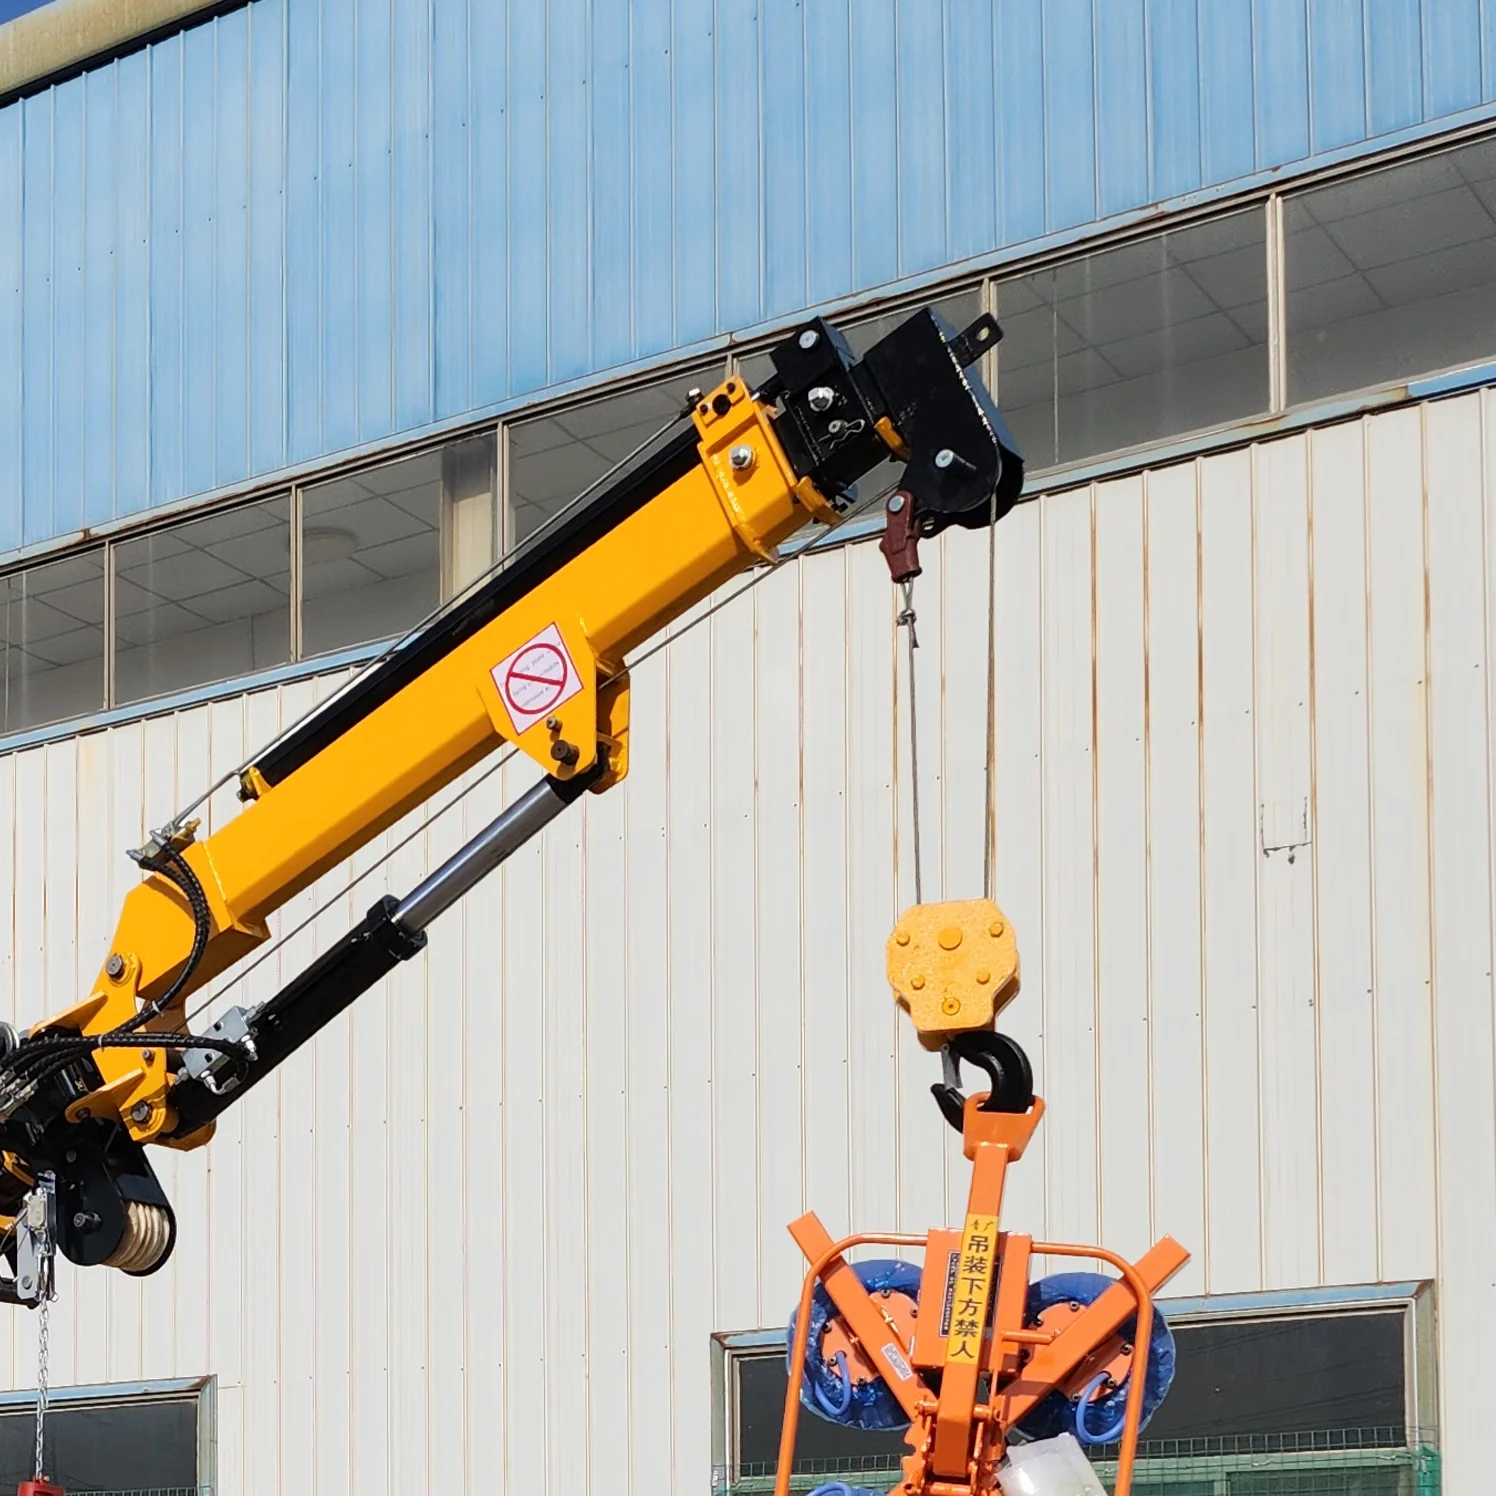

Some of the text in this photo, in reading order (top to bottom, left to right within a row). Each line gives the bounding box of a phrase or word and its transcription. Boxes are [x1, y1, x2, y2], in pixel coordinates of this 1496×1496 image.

[950, 1235, 990, 1359] 吊装下方禁人
